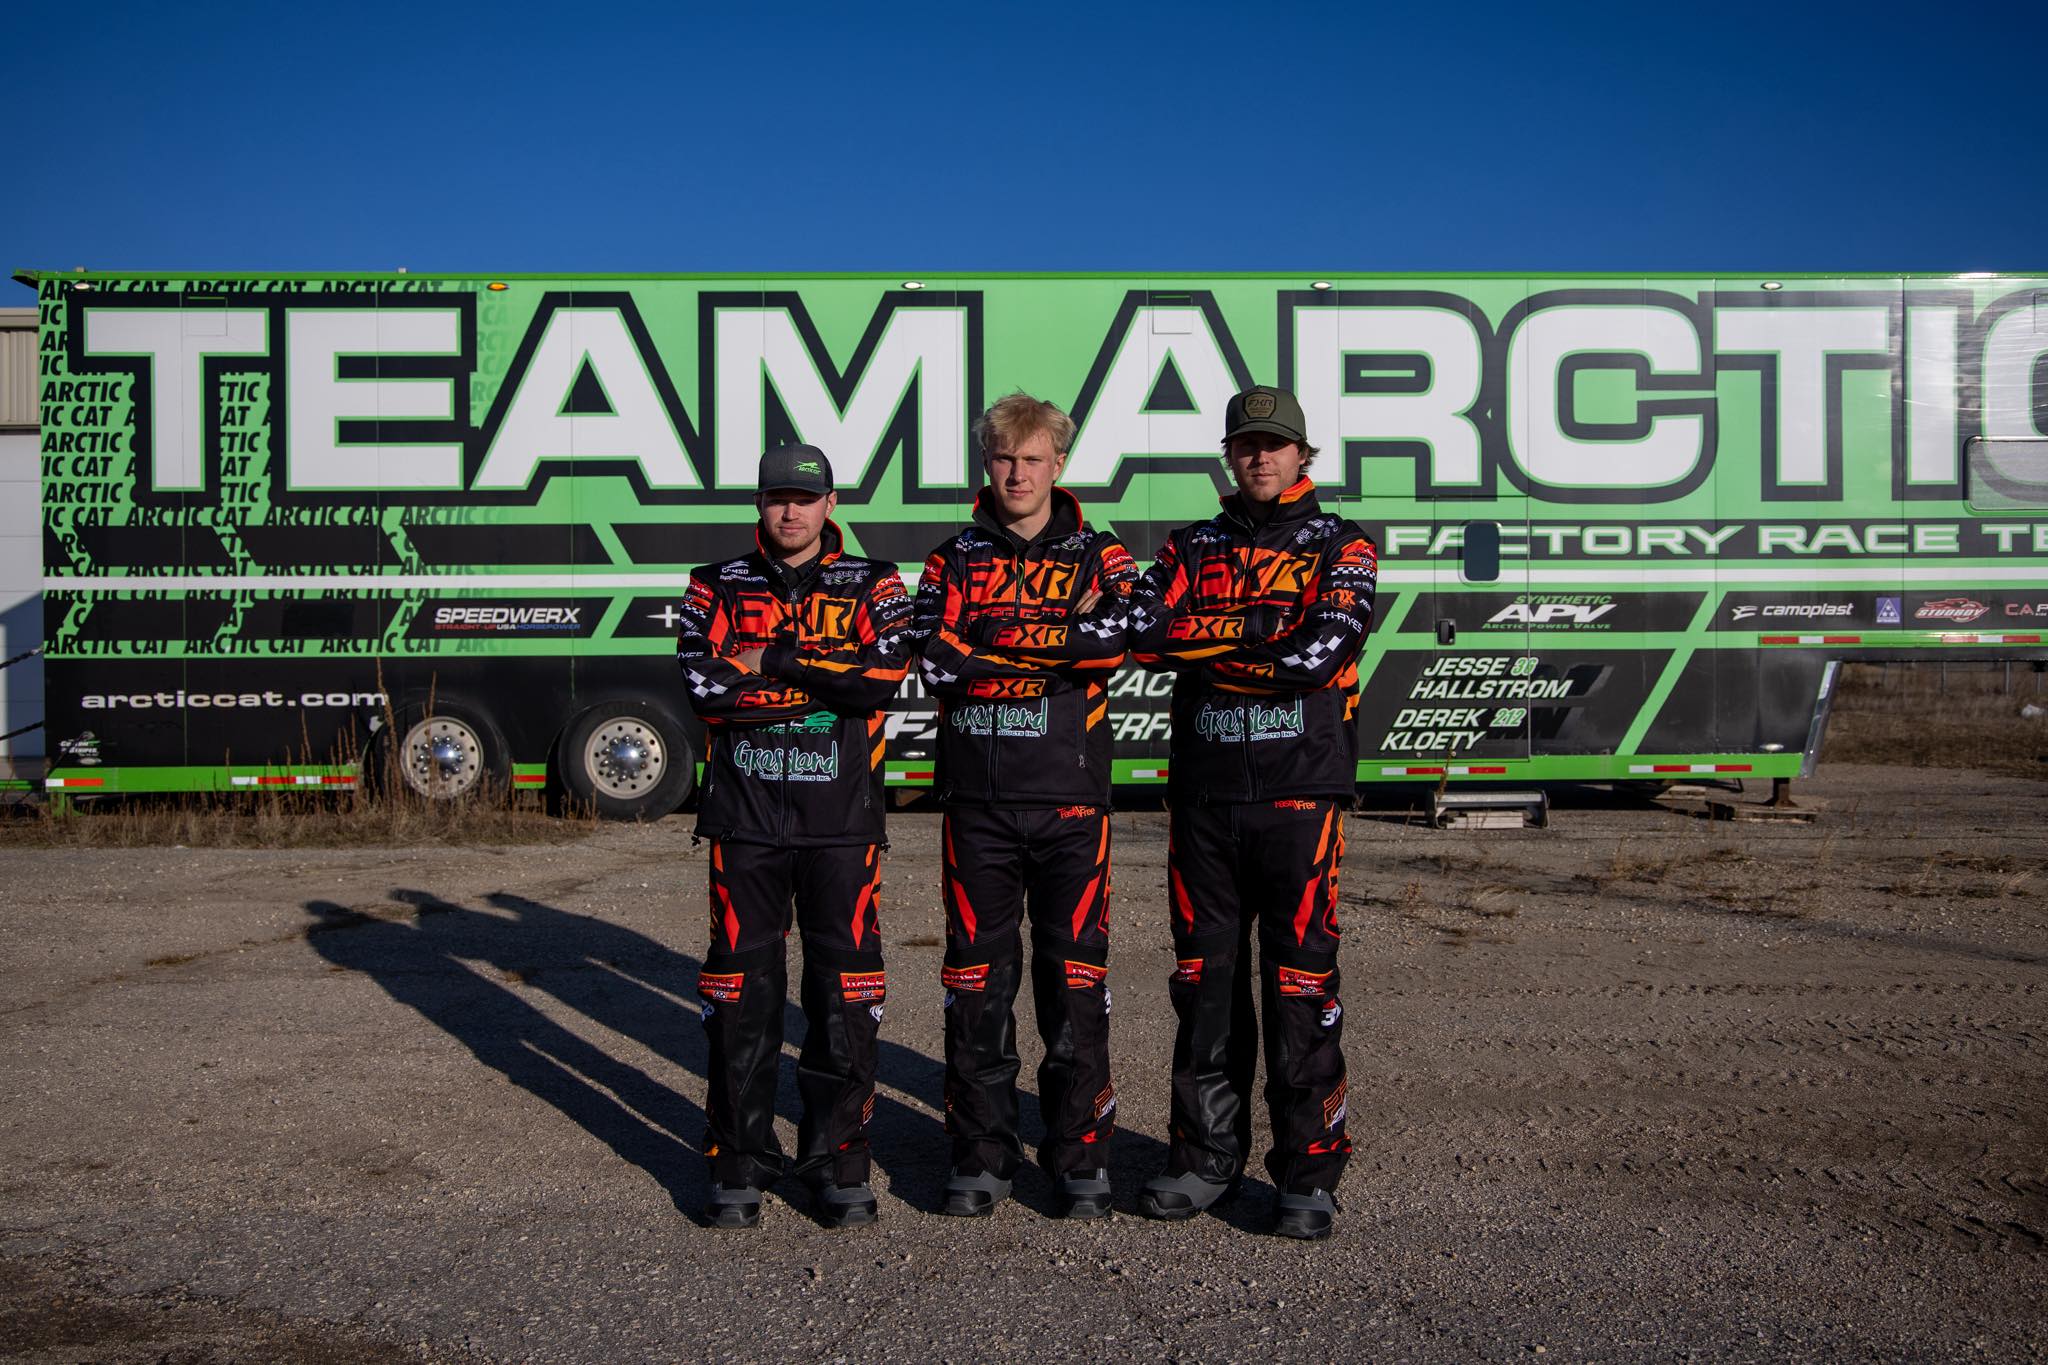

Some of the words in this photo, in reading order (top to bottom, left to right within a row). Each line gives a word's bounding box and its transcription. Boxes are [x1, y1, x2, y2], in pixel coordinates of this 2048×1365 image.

[42, 382, 122, 402] ARCTIC
[73, 296, 977, 499] TEAM
[71, 406, 112, 426] CAT
[43, 432, 123, 452] ARCTIC
[72, 457, 113, 477] CAT
[44, 482, 123, 503] ARCTIC
[73, 507, 114, 527] CAT
[1758, 524, 1961, 554] RACE
[1515, 595, 1613, 605] SYNTHETIC
[1762, 602, 1854, 618] camoplast
[435, 607, 581, 624] SPEEDWERX
[1486, 603, 1618, 623] APV
[990, 624, 1068, 649] FXR
[1167, 616, 1246, 640] FXR
[1423, 657, 1510, 676] JESSE
[966, 680, 1046, 698] FXR
[1408, 680, 1575, 699] HALLSTROM
[81, 690, 387, 709] arcticcat.com
[1393, 708, 1488, 728] DEREK
[1380, 731, 1487, 750] KLOETY
